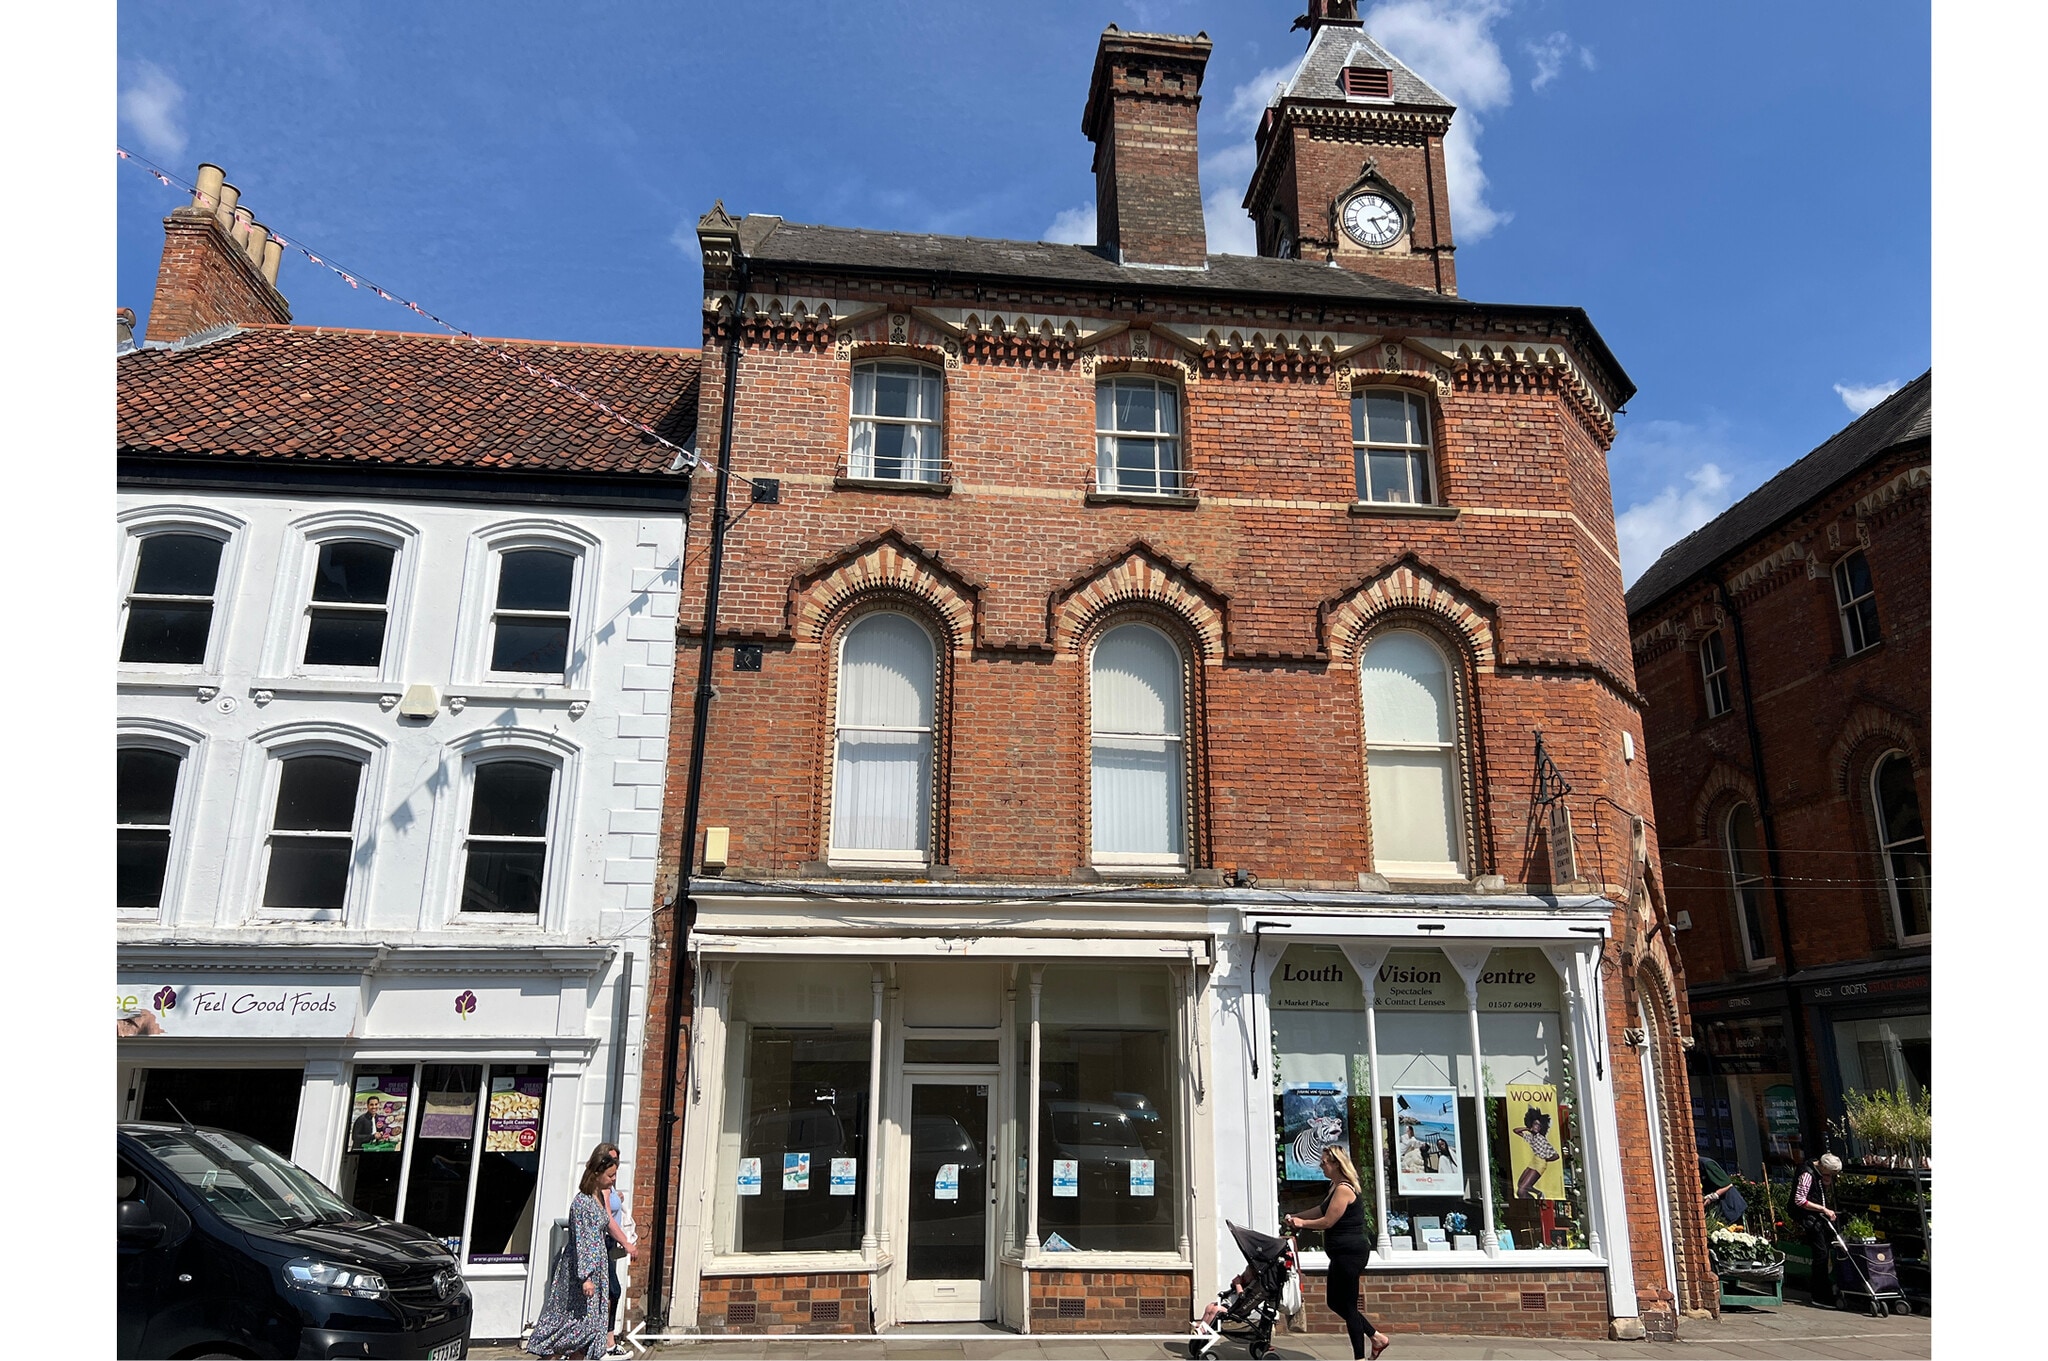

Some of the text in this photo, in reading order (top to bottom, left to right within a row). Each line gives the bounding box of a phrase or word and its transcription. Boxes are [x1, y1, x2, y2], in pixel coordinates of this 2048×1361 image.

[1283, 964, 1343, 982] Louth
[1379, 965, 1441, 983] Vision
[1390, 987, 1433, 996] Spectacles
[1814, 987, 1832, 997] SALES
[1840, 983, 1868, 996] CROFTS
[193, 992, 227, 1015] Feel
[231, 992, 287, 1014] Good
[290, 992, 337, 1016] Foods
[1283, 999, 1309, 1007] Market
[1310, 999, 1330, 1007] Place
[1384, 997, 1416, 1006] Contact
[1418, 998, 1446, 1006] Lenses
[1510, 1091, 1553, 1102] WOOW
